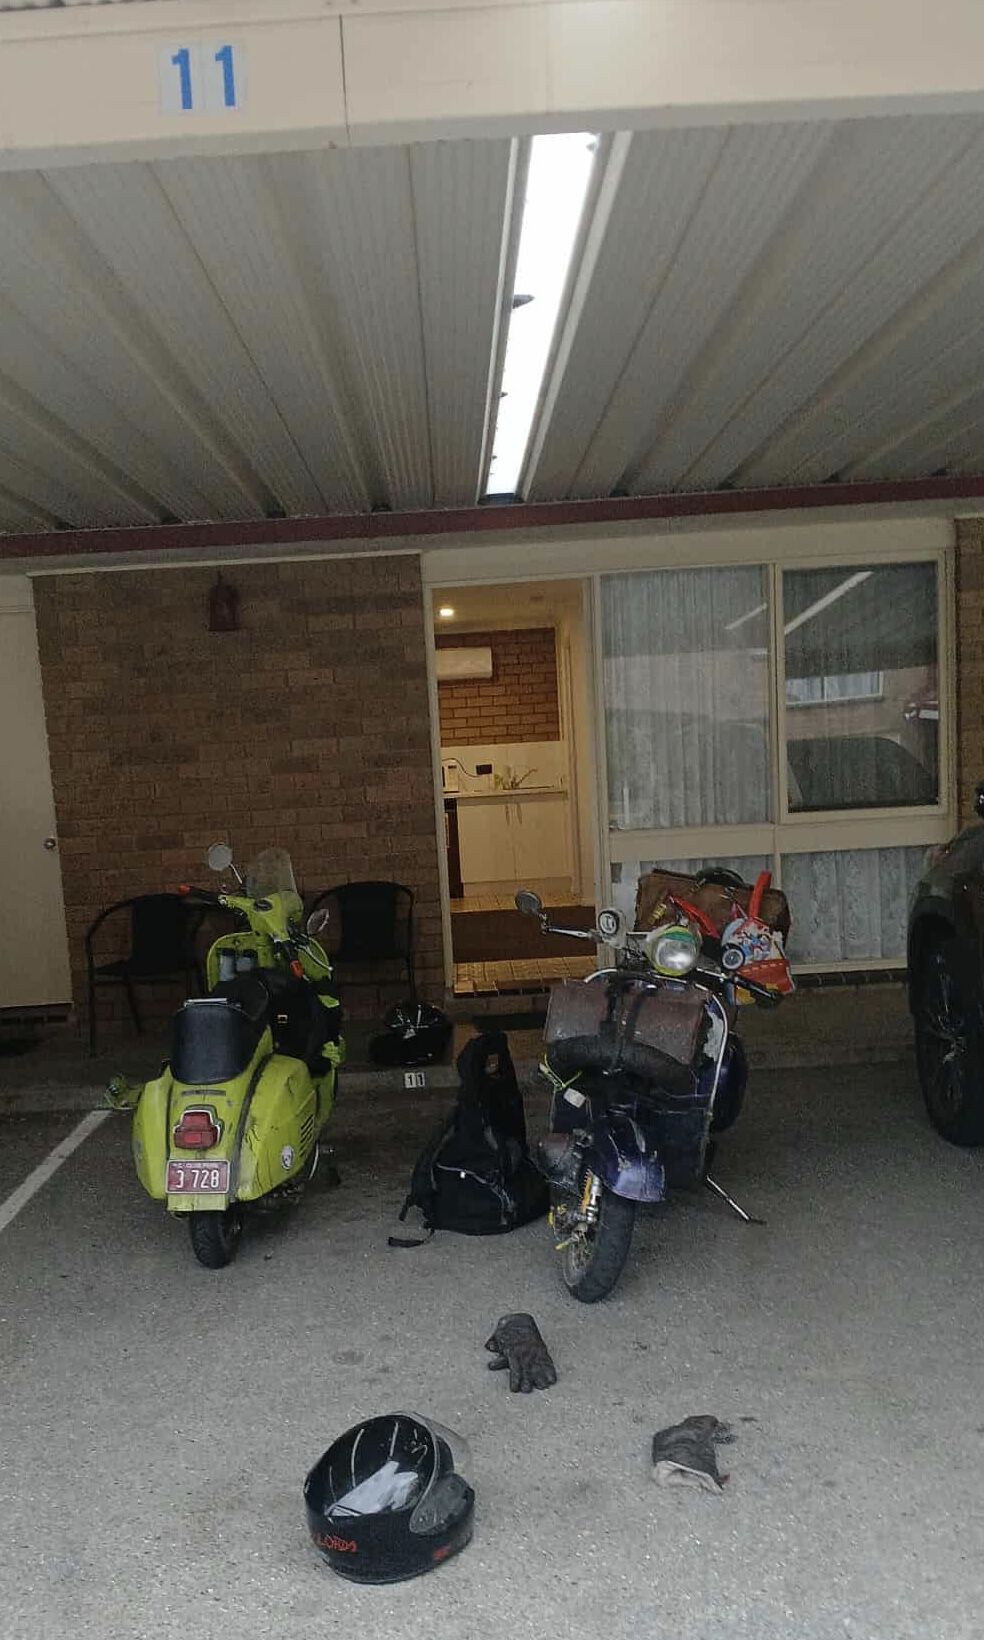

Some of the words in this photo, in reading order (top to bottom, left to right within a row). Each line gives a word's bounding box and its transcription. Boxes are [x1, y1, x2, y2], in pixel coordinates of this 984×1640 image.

[171, 45, 236, 110] 11
[408, 1074, 423, 1086] 11
[191, 1169, 220, 1188] 728
